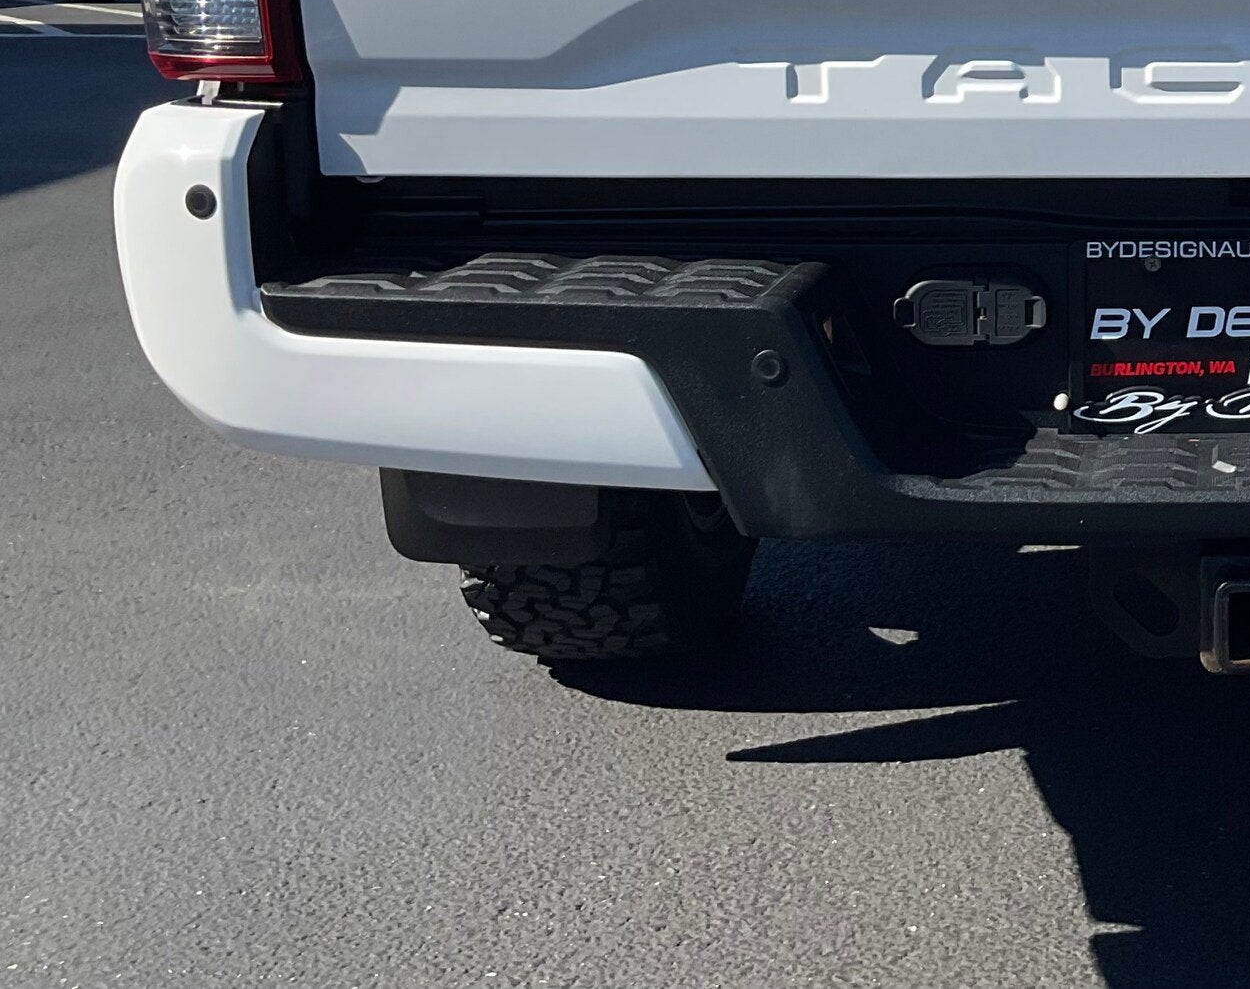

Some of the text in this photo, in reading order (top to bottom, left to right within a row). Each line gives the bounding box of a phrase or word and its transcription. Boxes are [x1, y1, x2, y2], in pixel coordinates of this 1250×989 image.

[1090, 307, 1171, 340] BY
[1090, 360, 1236, 377] BURLINGTON, WA
[1074, 388, 1198, 435] By
